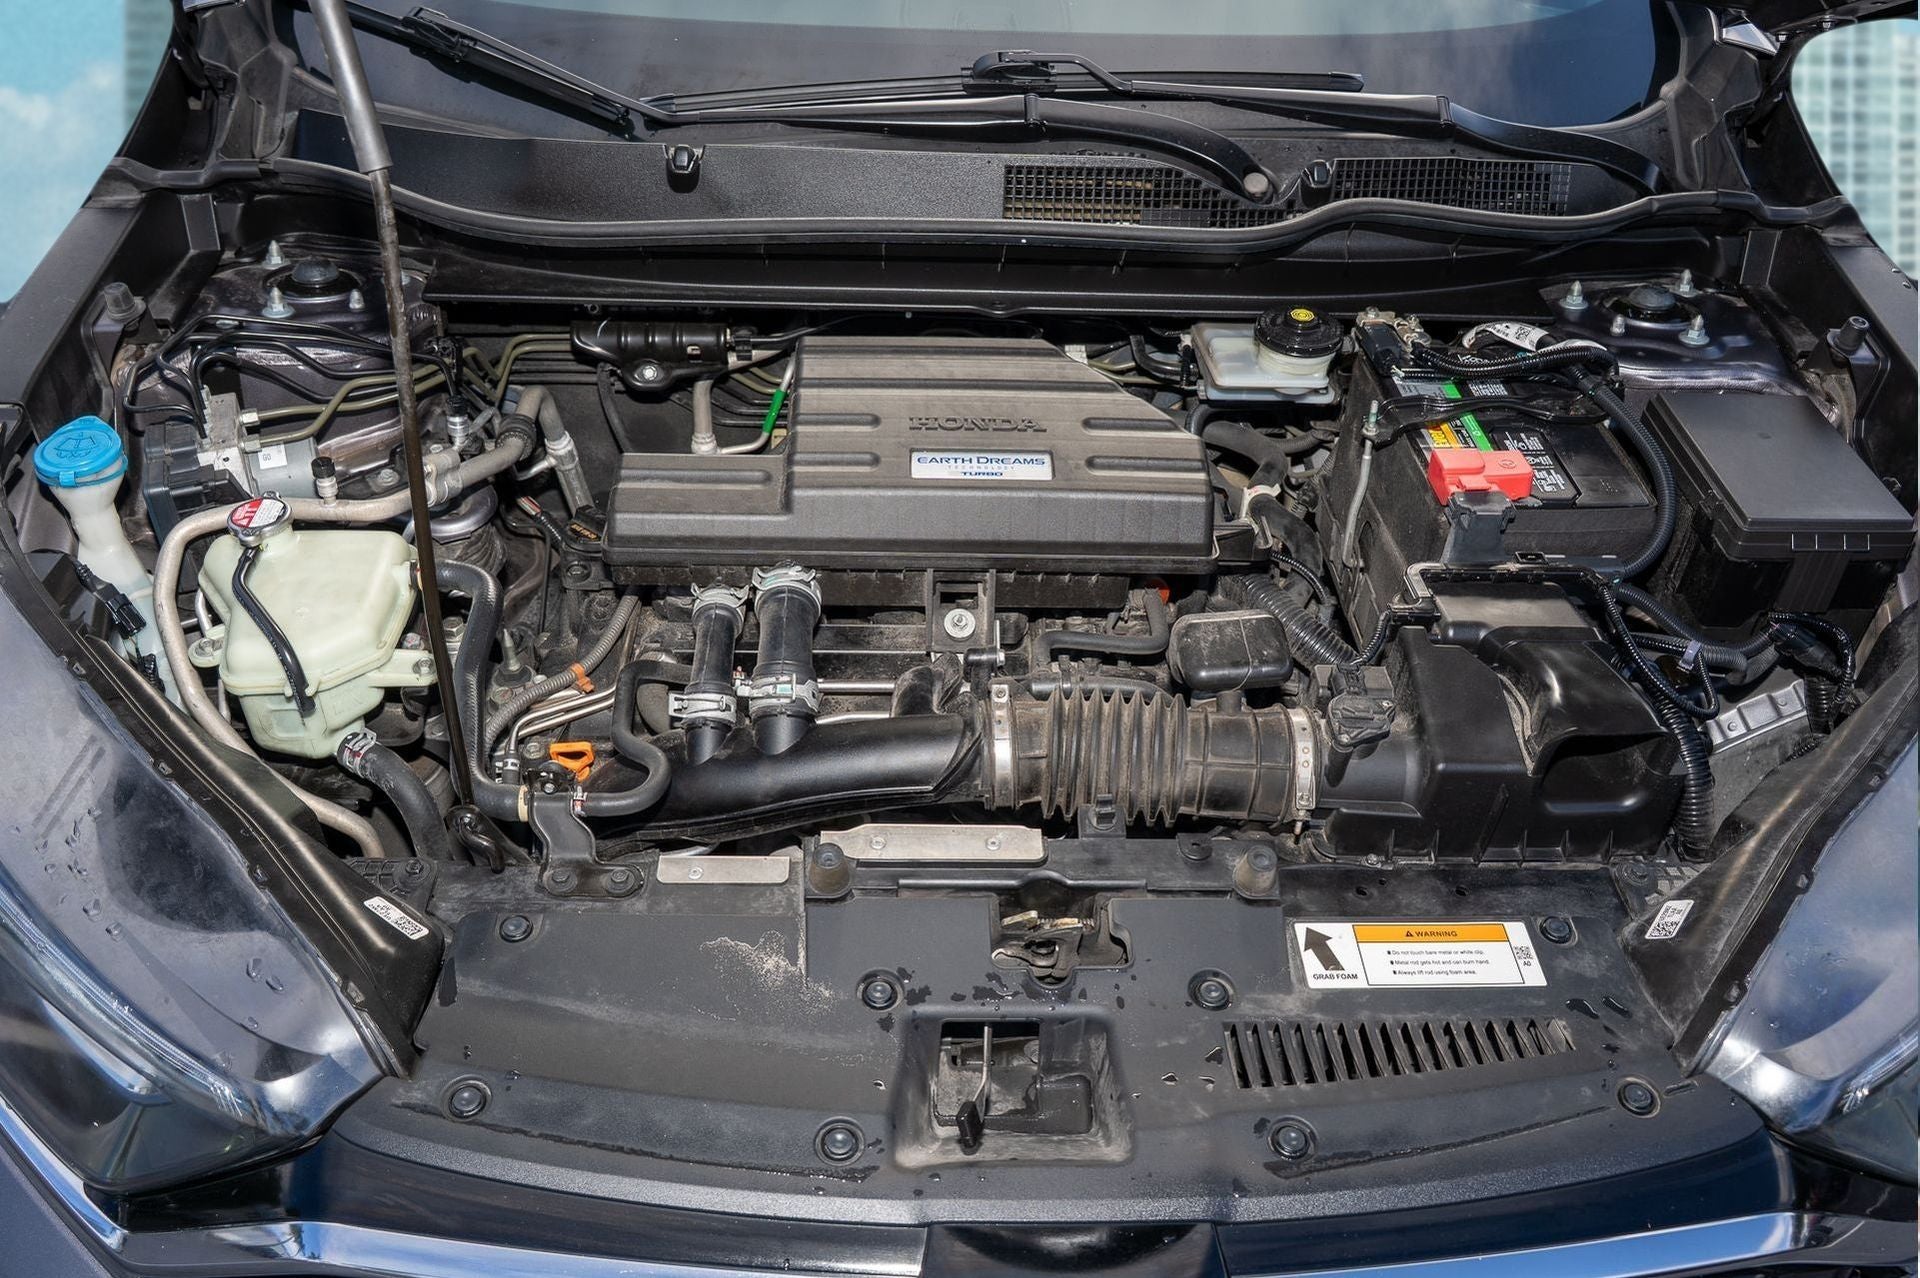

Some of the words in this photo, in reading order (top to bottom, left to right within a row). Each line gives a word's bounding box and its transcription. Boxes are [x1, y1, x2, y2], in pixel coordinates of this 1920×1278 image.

[909, 416, 1047, 433] HONDA
[917, 456, 973, 465] EARTH
[976, 456, 1046, 465] DREAMS
[1415, 930, 1458, 938] WARNING
